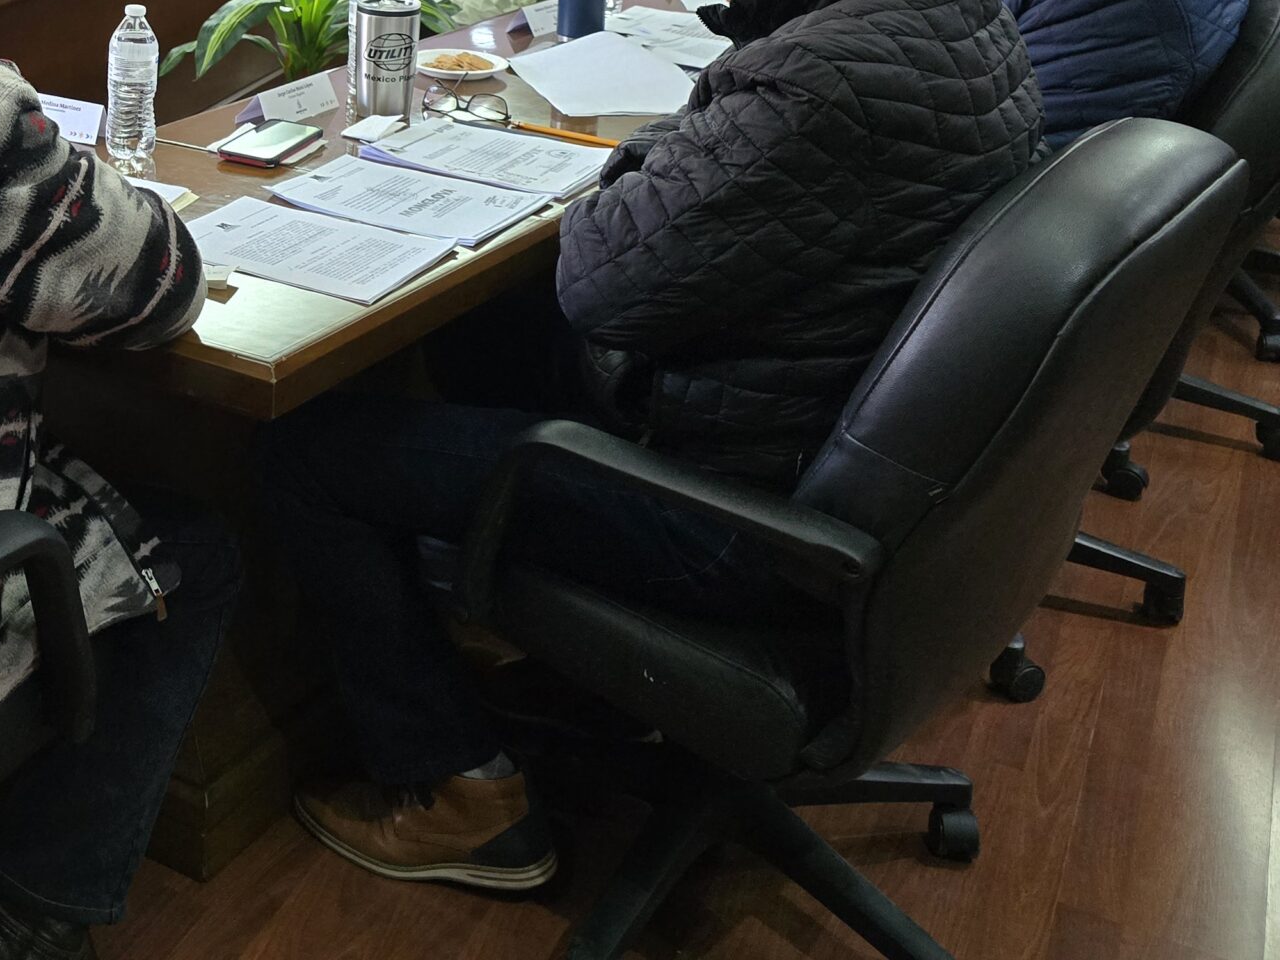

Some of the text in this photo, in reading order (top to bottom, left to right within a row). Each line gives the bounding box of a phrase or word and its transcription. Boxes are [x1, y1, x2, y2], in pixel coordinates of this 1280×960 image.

[367, 43, 416, 60] UTILITY
[364, 72, 396, 83] Mexico
[399, 189, 457, 218] MONCLOVA
